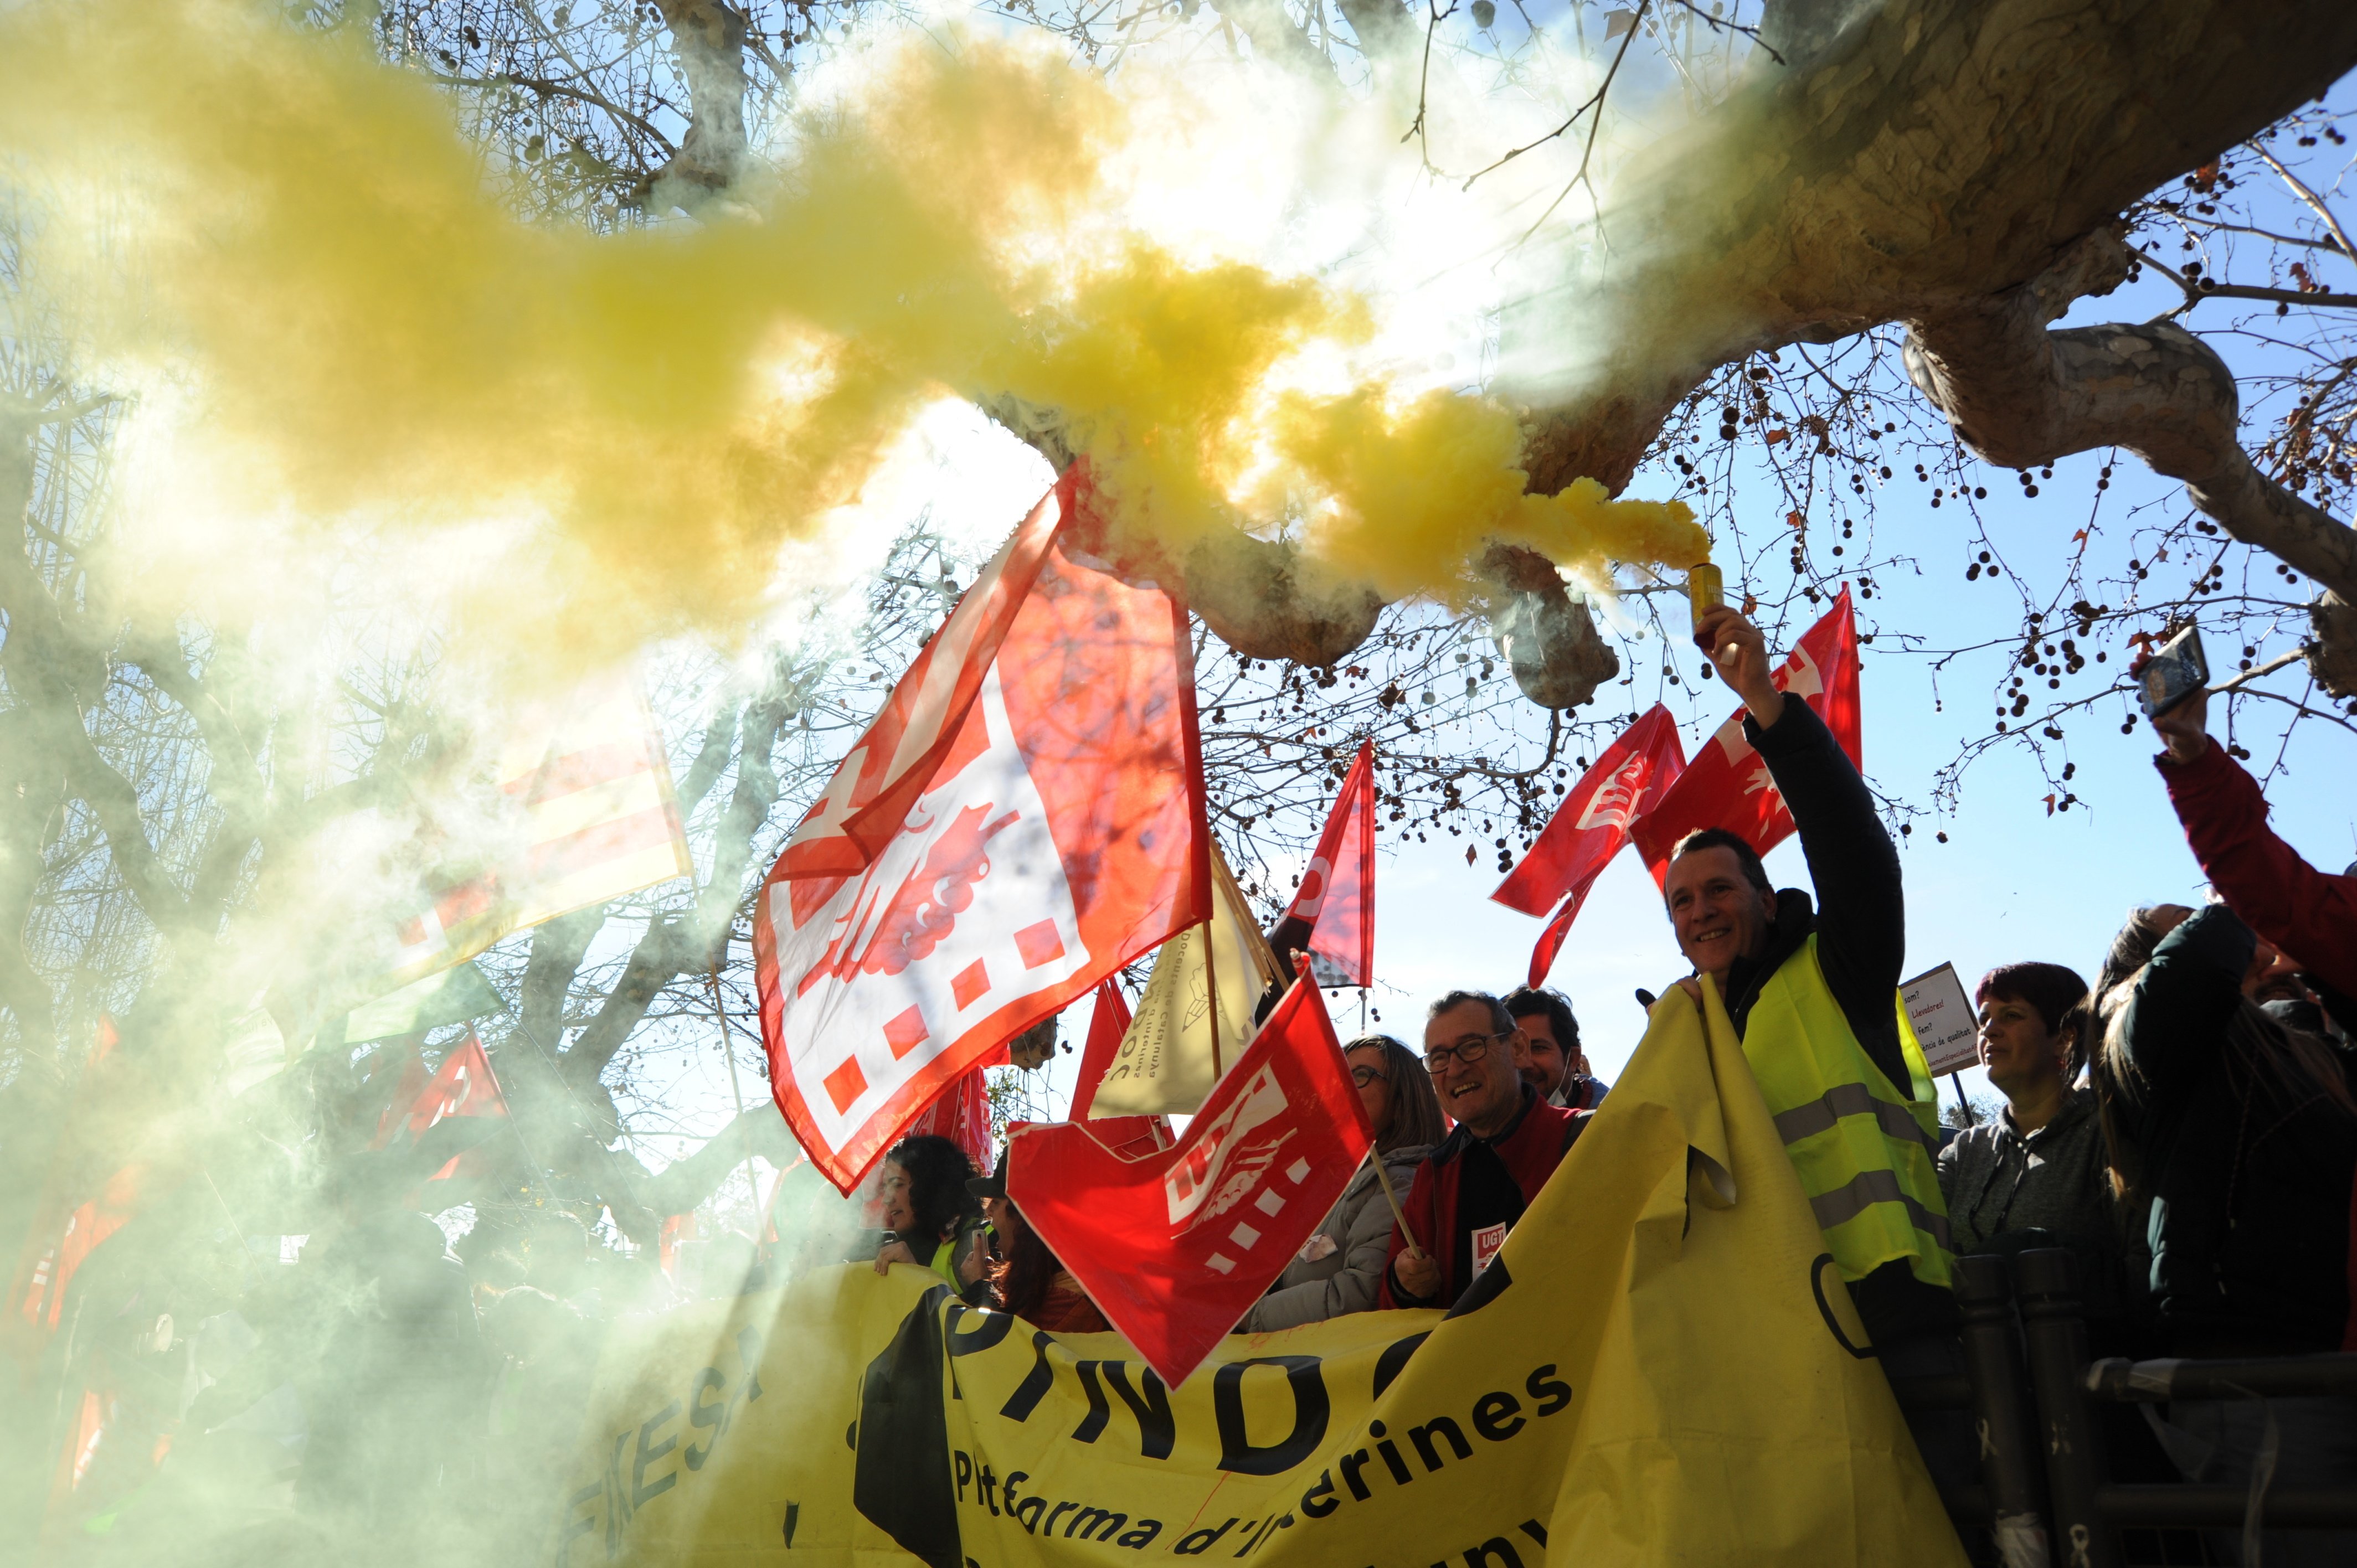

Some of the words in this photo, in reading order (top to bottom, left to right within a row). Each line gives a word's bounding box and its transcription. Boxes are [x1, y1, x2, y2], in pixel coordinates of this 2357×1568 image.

[1905, 991, 1919, 1004] som?
[1912, 999, 1944, 1019] Llevadores!
[1918, 1023, 1932, 1036] fem?
[1921, 1041, 1936, 1052] ència
[1938, 1038, 1945, 1046] de
[1947, 1028, 1971, 1044] qualitat
[1482, 1230, 1504, 1249] UGT
